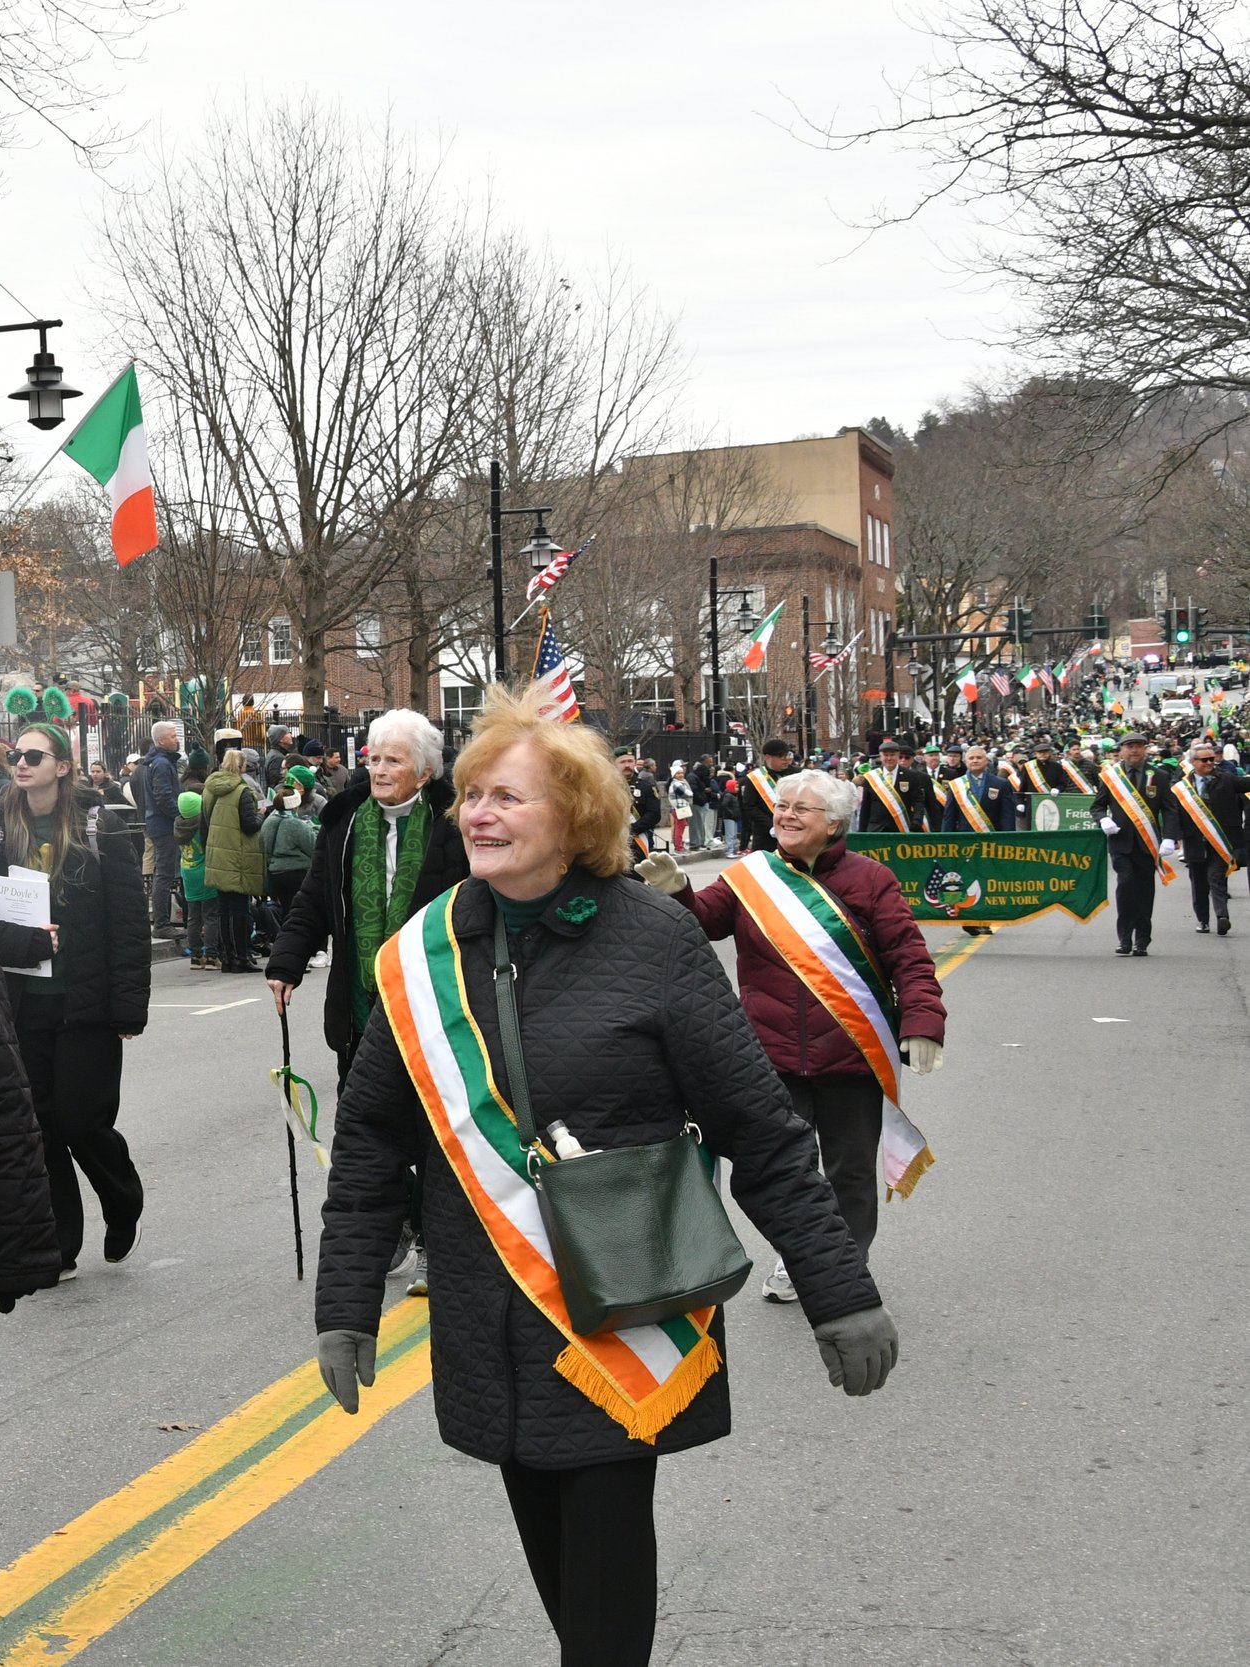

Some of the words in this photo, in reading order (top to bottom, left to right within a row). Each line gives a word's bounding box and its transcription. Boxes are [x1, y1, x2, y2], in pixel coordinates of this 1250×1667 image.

[896, 843, 959, 860] ORDER
[962, 843, 980, 858] of
[980, 841, 1092, 871] HIBERNIANS
[987, 878, 1045, 893] DIVISION
[1049, 877, 1077, 893] ONE
[985, 896, 1008, 906] NEW
[1010, 895, 1040, 905] YORK
